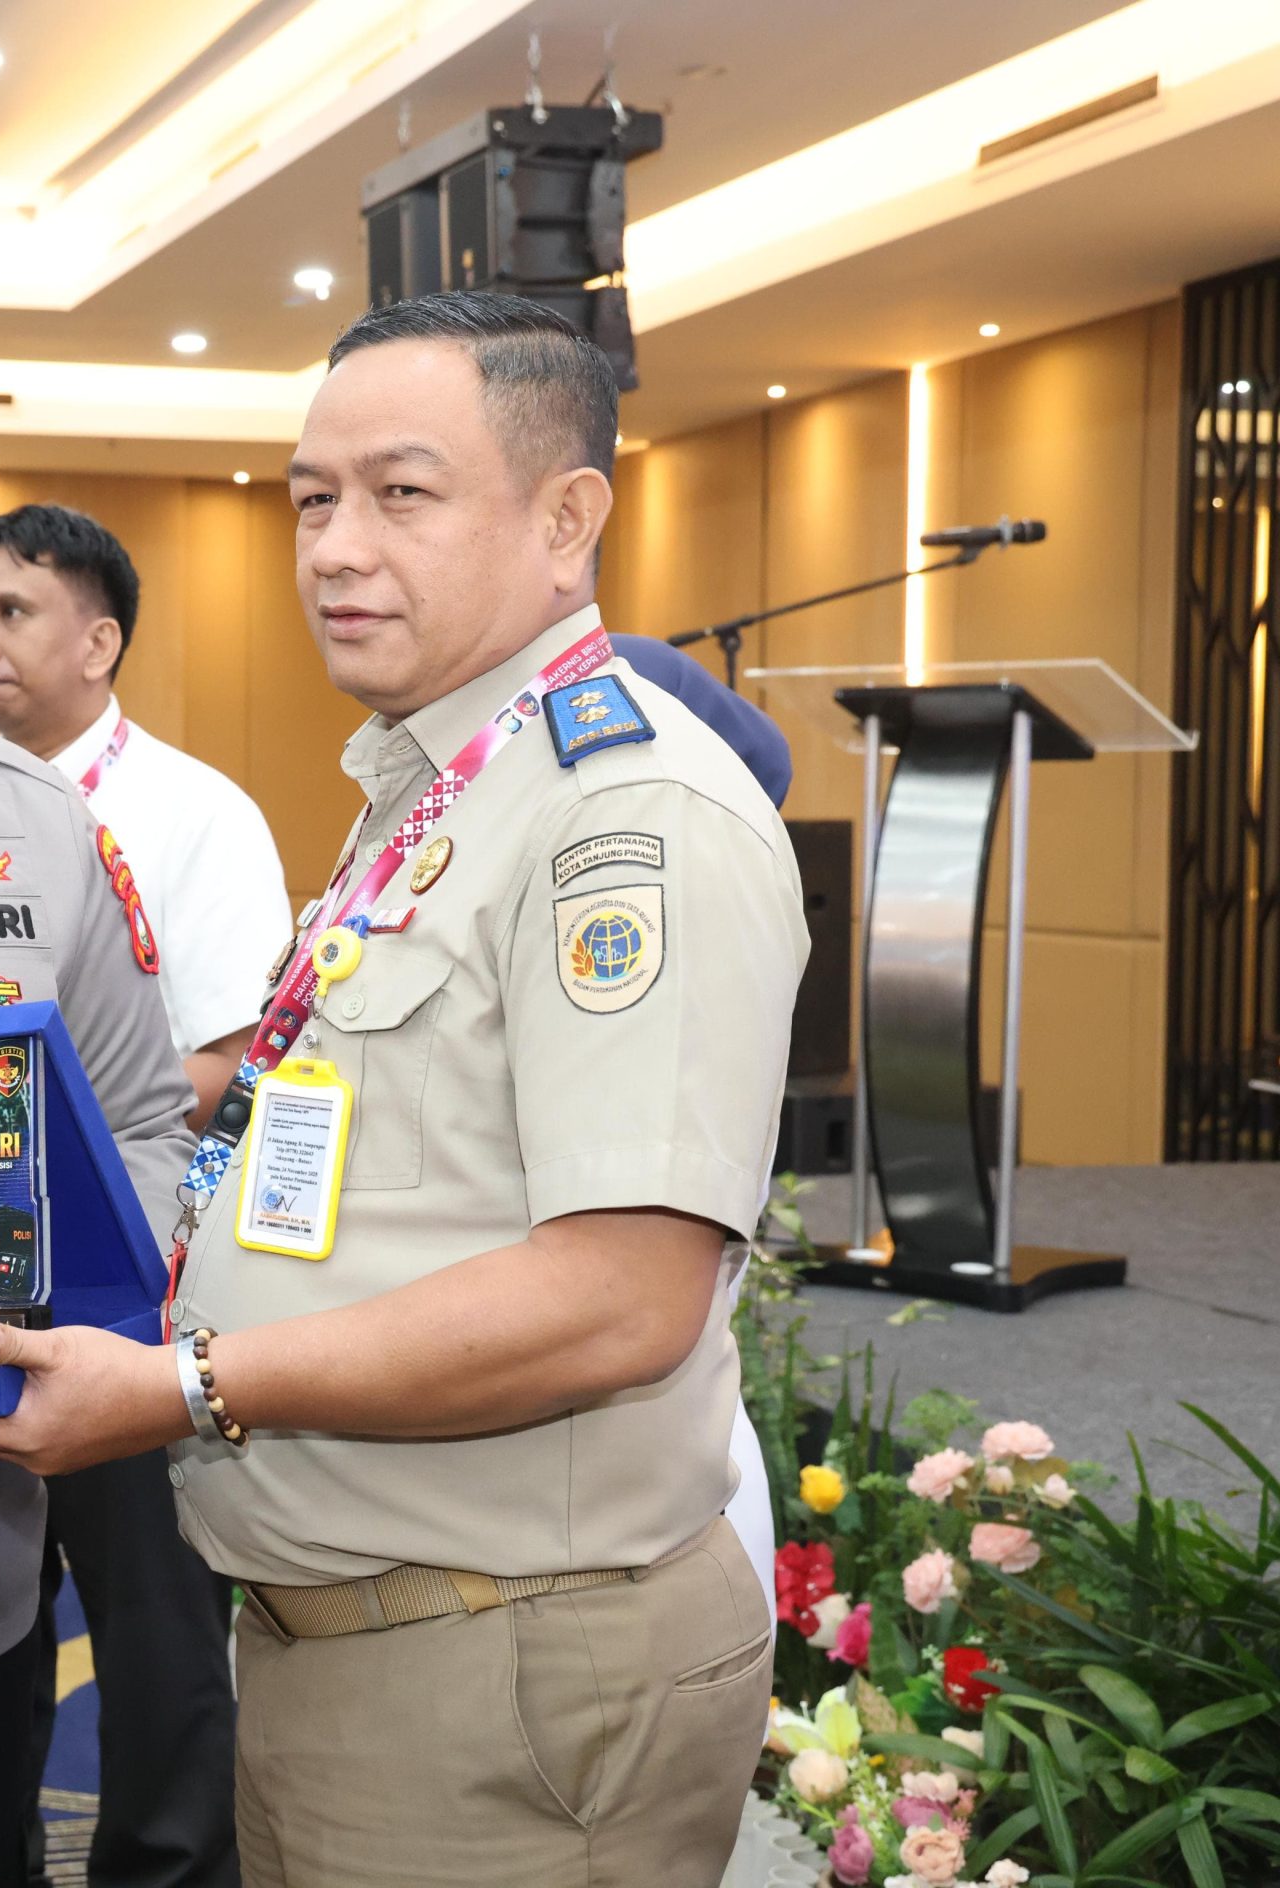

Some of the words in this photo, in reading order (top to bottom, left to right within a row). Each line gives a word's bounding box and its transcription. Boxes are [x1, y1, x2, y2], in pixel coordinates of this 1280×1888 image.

[557, 844, 592, 869] KANTOR
[594, 837, 659, 851] PERTANAHAN
[558, 862, 582, 880] KOTA
[582, 849, 623, 866] TANJUNG
[624, 849, 659, 862] PINANG
[13, 1230, 32, 1241] POLISI
